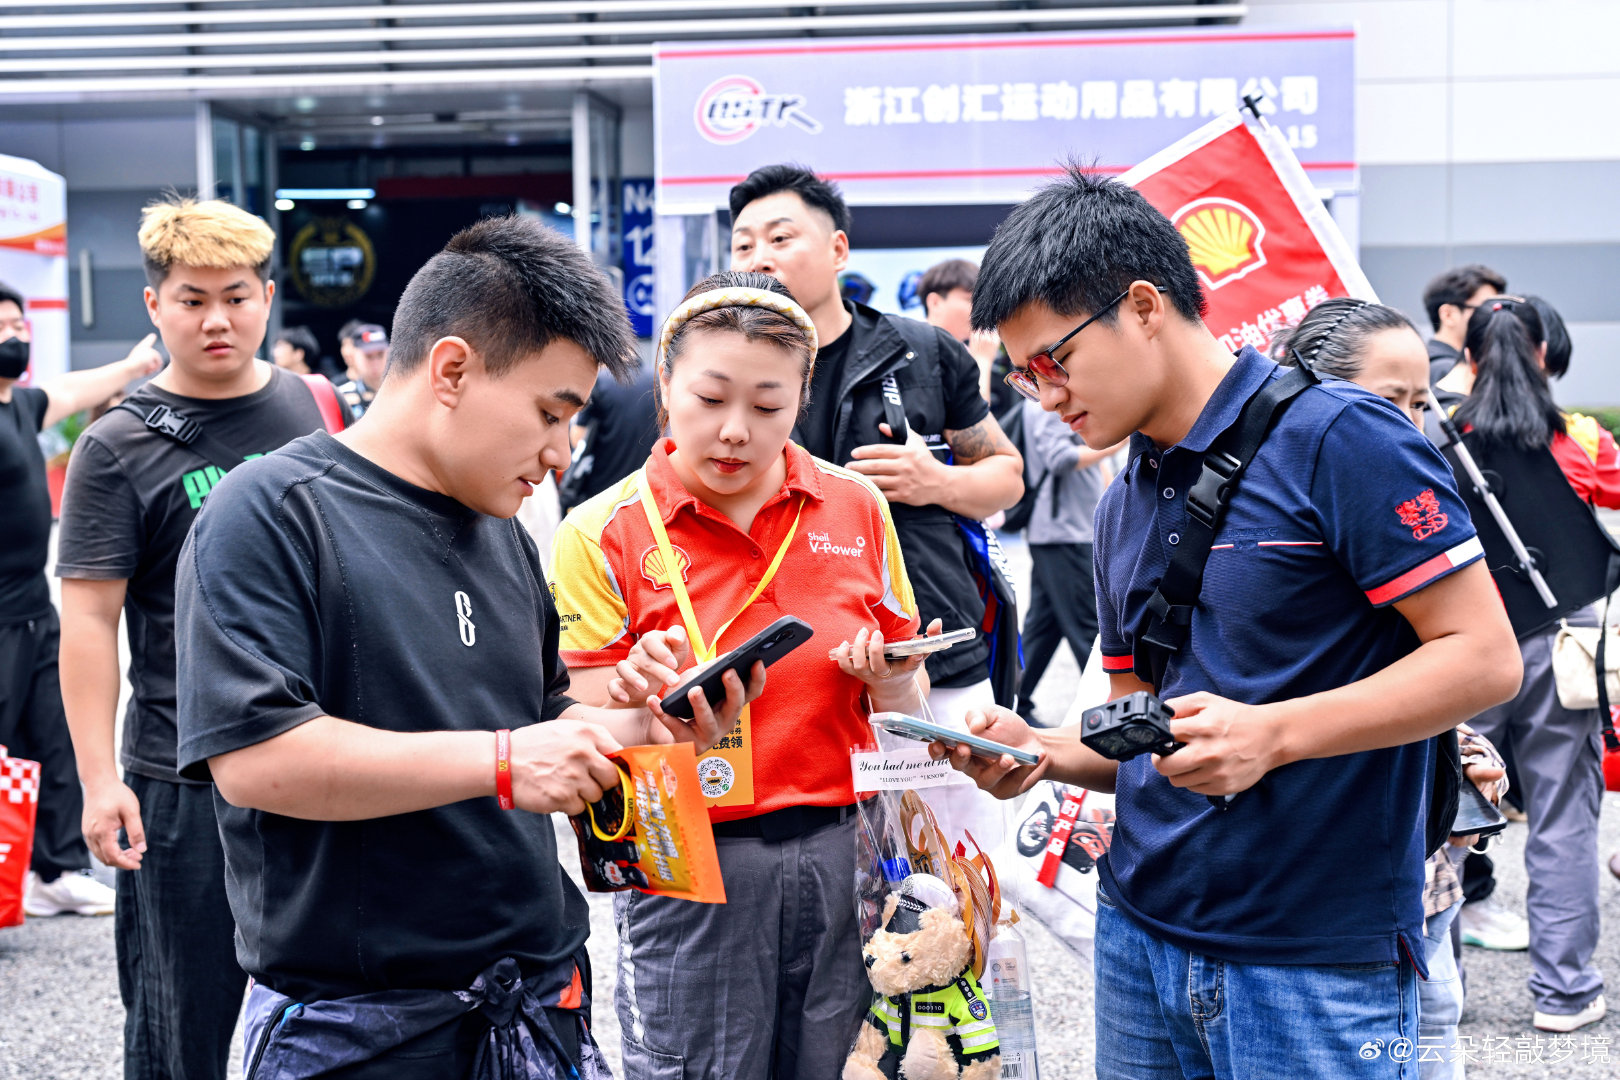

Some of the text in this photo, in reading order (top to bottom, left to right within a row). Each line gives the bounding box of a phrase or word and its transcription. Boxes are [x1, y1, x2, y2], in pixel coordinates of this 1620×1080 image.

[844, 76, 1318, 125] 浙江创汇运动用品有限公司
[808, 531, 830, 542] Shell
[809, 541, 863, 558] V-Power
[859, 760, 880, 771] You
[883, 759, 904, 771] had
[906, 762, 922, 770] me
